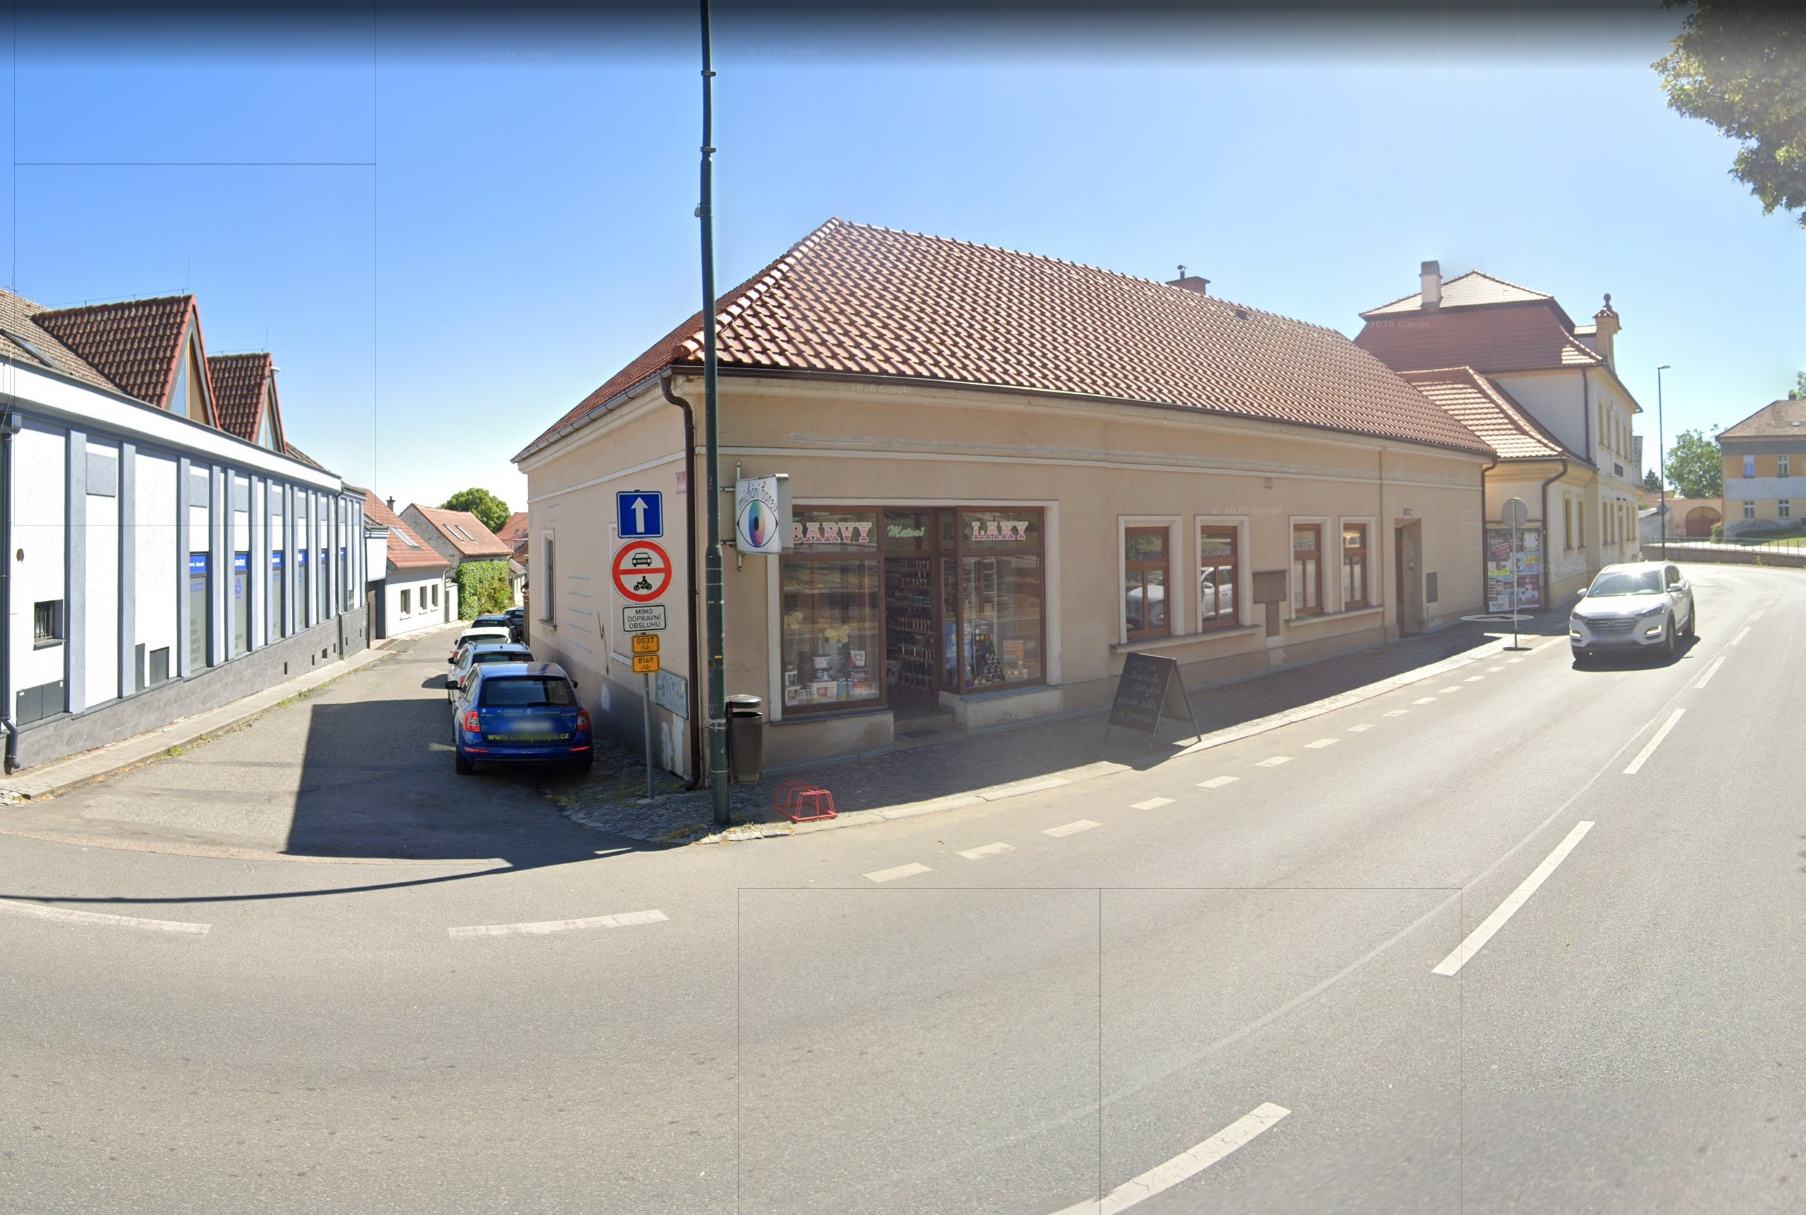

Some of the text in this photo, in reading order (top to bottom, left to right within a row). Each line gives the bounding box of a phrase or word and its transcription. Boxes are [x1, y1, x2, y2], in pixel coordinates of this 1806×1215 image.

[792, 522, 873, 544] BARVY
[971, 521, 1029, 541] LAKY
[635, 608, 653, 616] MIMO
[627, 613, 662, 623] DOPRAVNÍ
[629, 621, 661, 629] OBSLUHU
[636, 637, 655, 645] 0037
[638, 656, 655, 664] 8149
